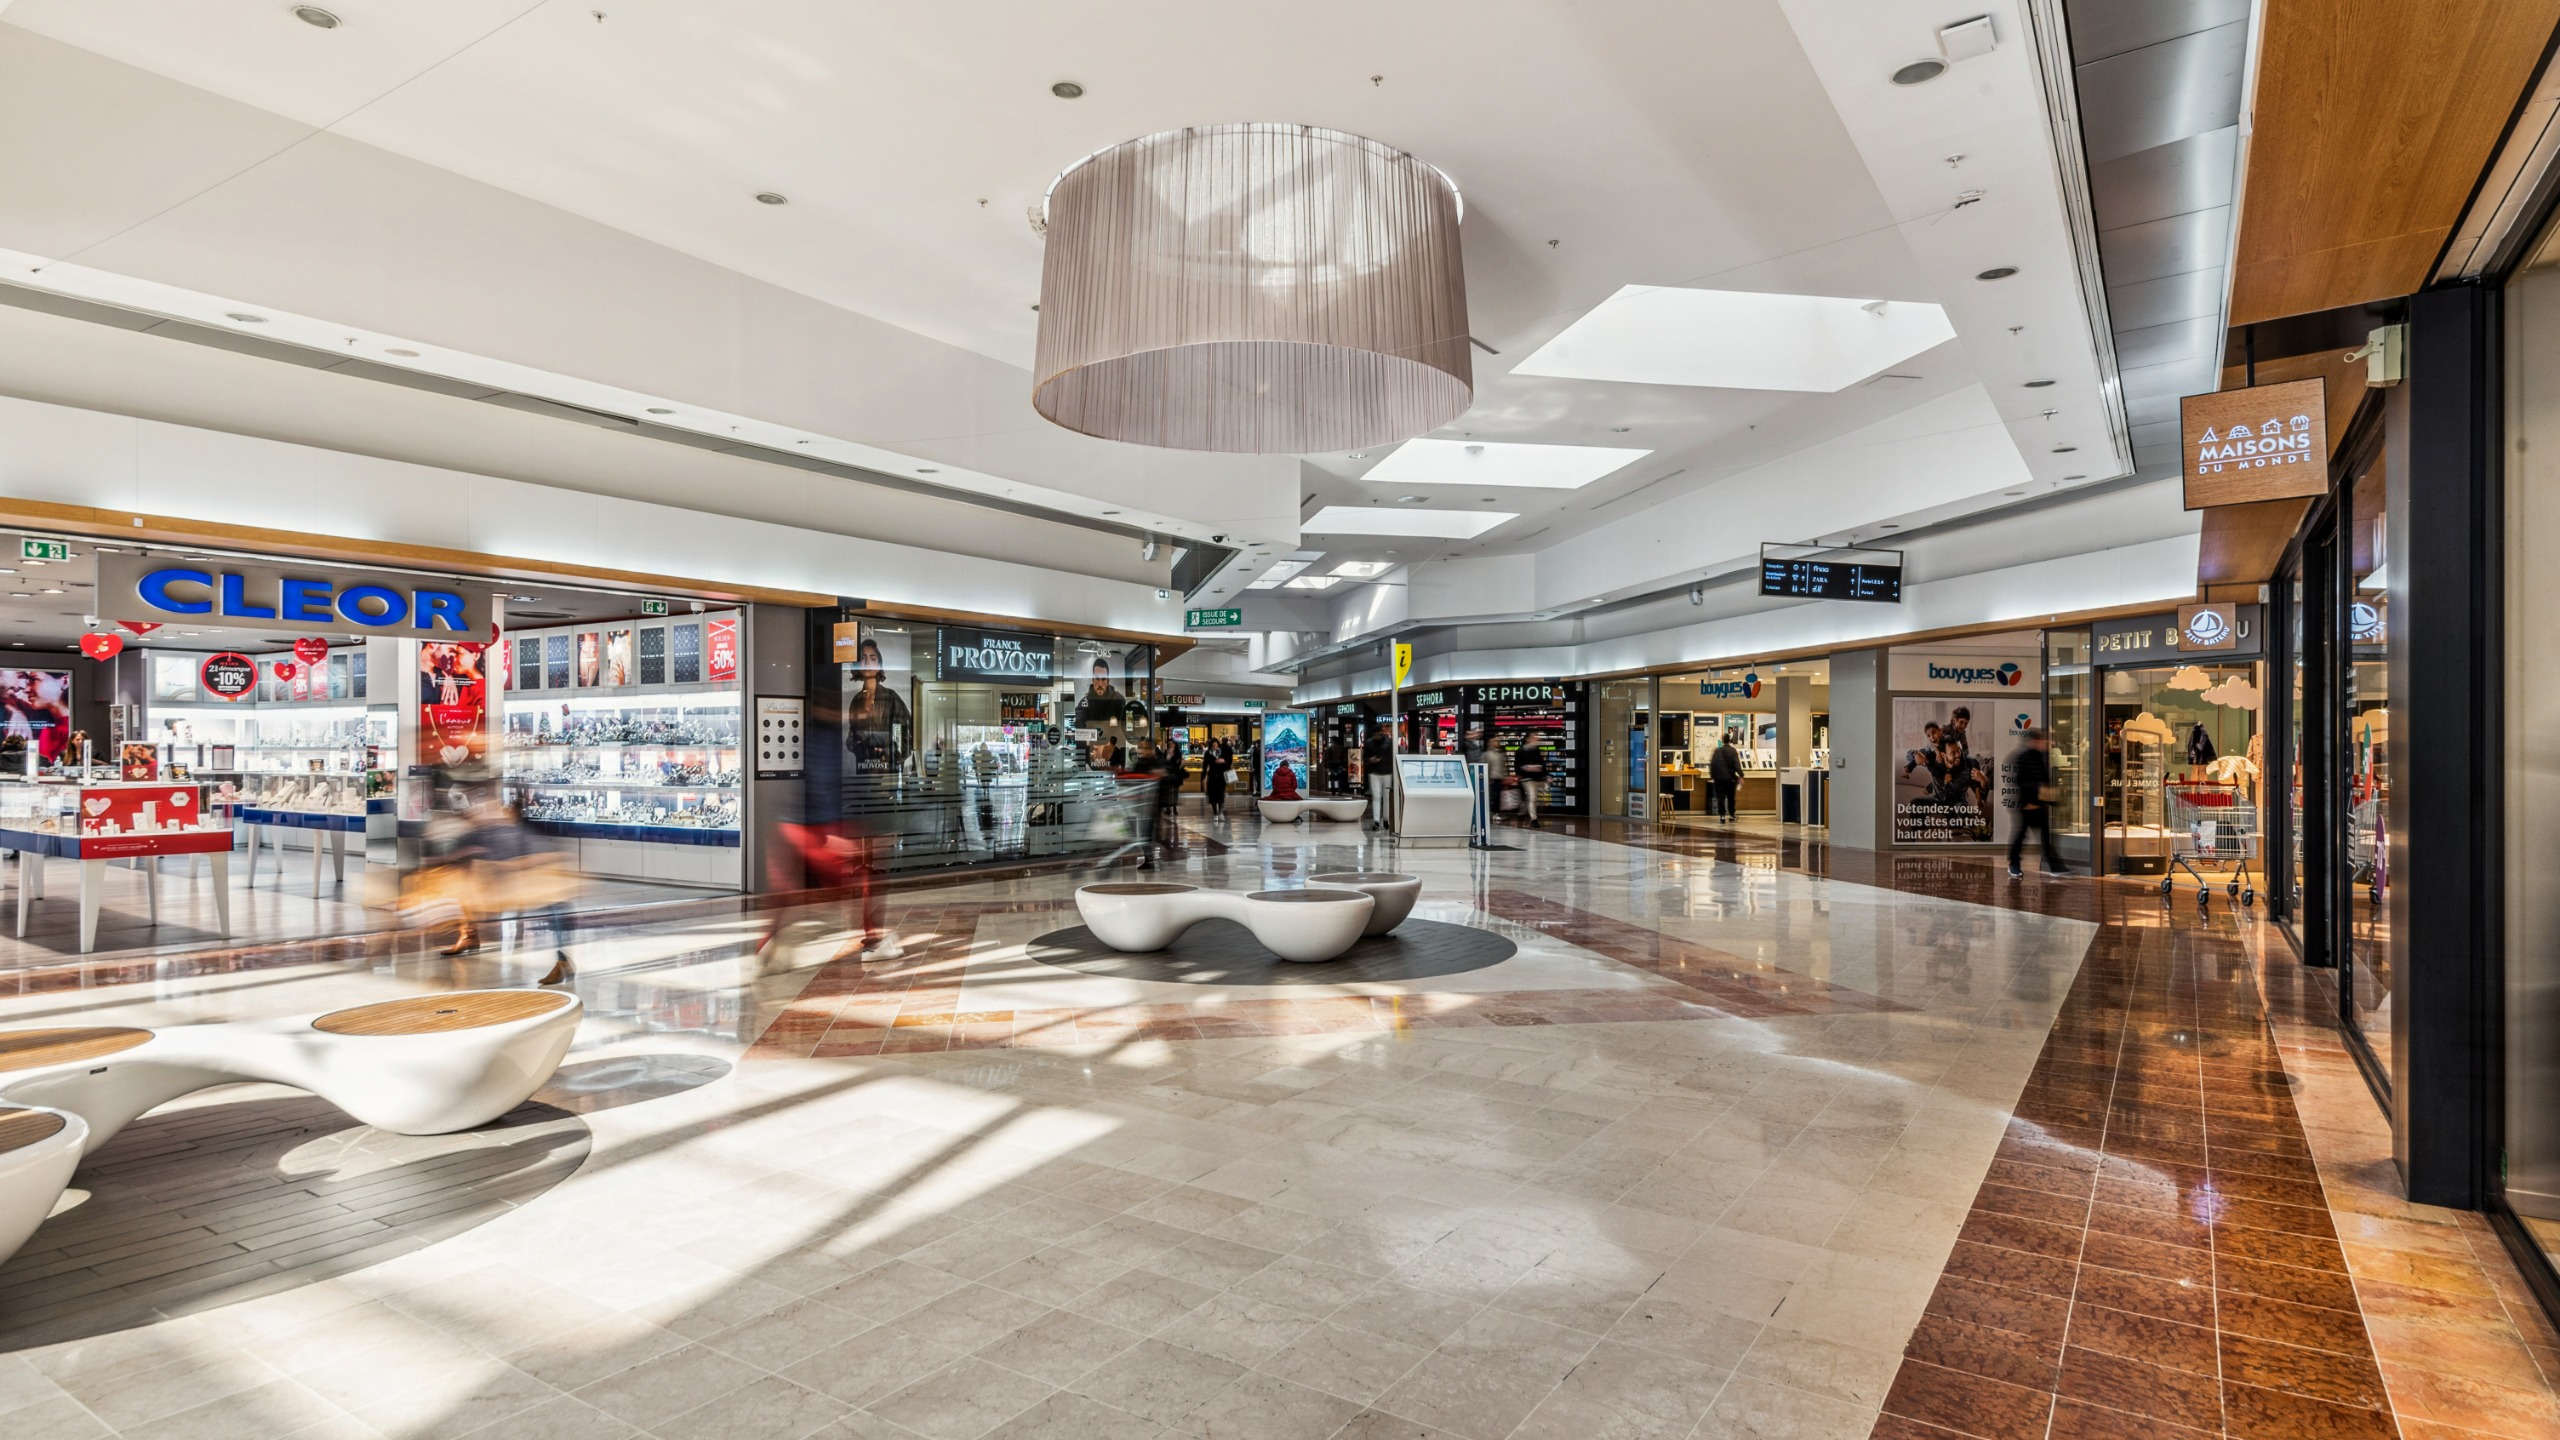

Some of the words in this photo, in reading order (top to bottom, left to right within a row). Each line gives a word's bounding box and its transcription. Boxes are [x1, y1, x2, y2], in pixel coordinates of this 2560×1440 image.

[2199, 433, 2311, 461] MAISONS
[2199, 464, 2222, 475] DU
[2238, 452, 2311, 470] MONDE
[135, 568, 470, 632] CLEOR
[983, 638, 1022, 650] FRANCK
[2098, 630, 2152, 651] PETIT
[2184, 629, 2203, 645] PETIT
[2204, 625, 2230, 646] BATEAU
[710, 650, 735, 669] -50%
[949, 645, 1050, 673] PROVOST
[213, 672, 245, 686] -10%
[1928, 663, 1996, 684] bouygues
[1700, 679, 1743, 698] bouygues
[1416, 692, 1443, 706] SEPHORA
[1337, 703, 1355, 715] SEPHORA
[2001, 764, 2011, 772] Ici
[1897, 803, 1982, 815] Détendez-vous,
[1897, 817, 1923, 826] vous
[1924, 816, 1948, 826] êtes
[1949, 817, 1963, 826] en
[1964, 816, 1986, 826] très
[1897, 829, 1922, 839] haut
[1924, 828, 1953, 839] débit
